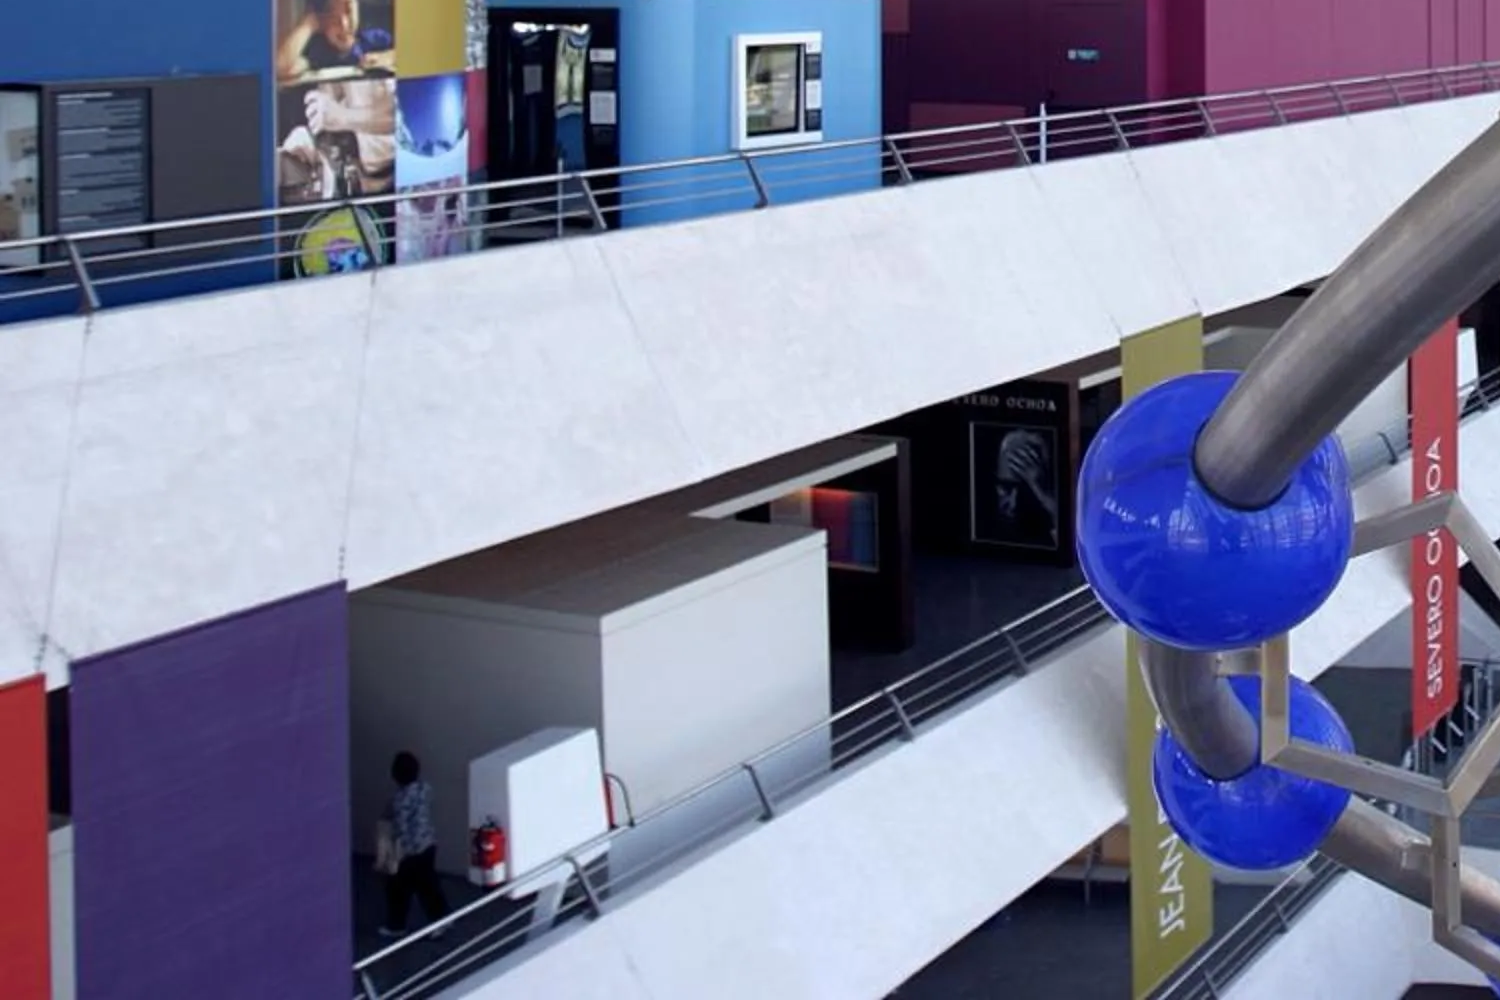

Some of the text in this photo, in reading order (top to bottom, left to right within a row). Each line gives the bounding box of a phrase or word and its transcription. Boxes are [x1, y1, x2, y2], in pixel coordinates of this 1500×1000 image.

[1425, 436, 1443, 698] SEVERO OOA
[1157, 833, 1185, 938] JEAN
